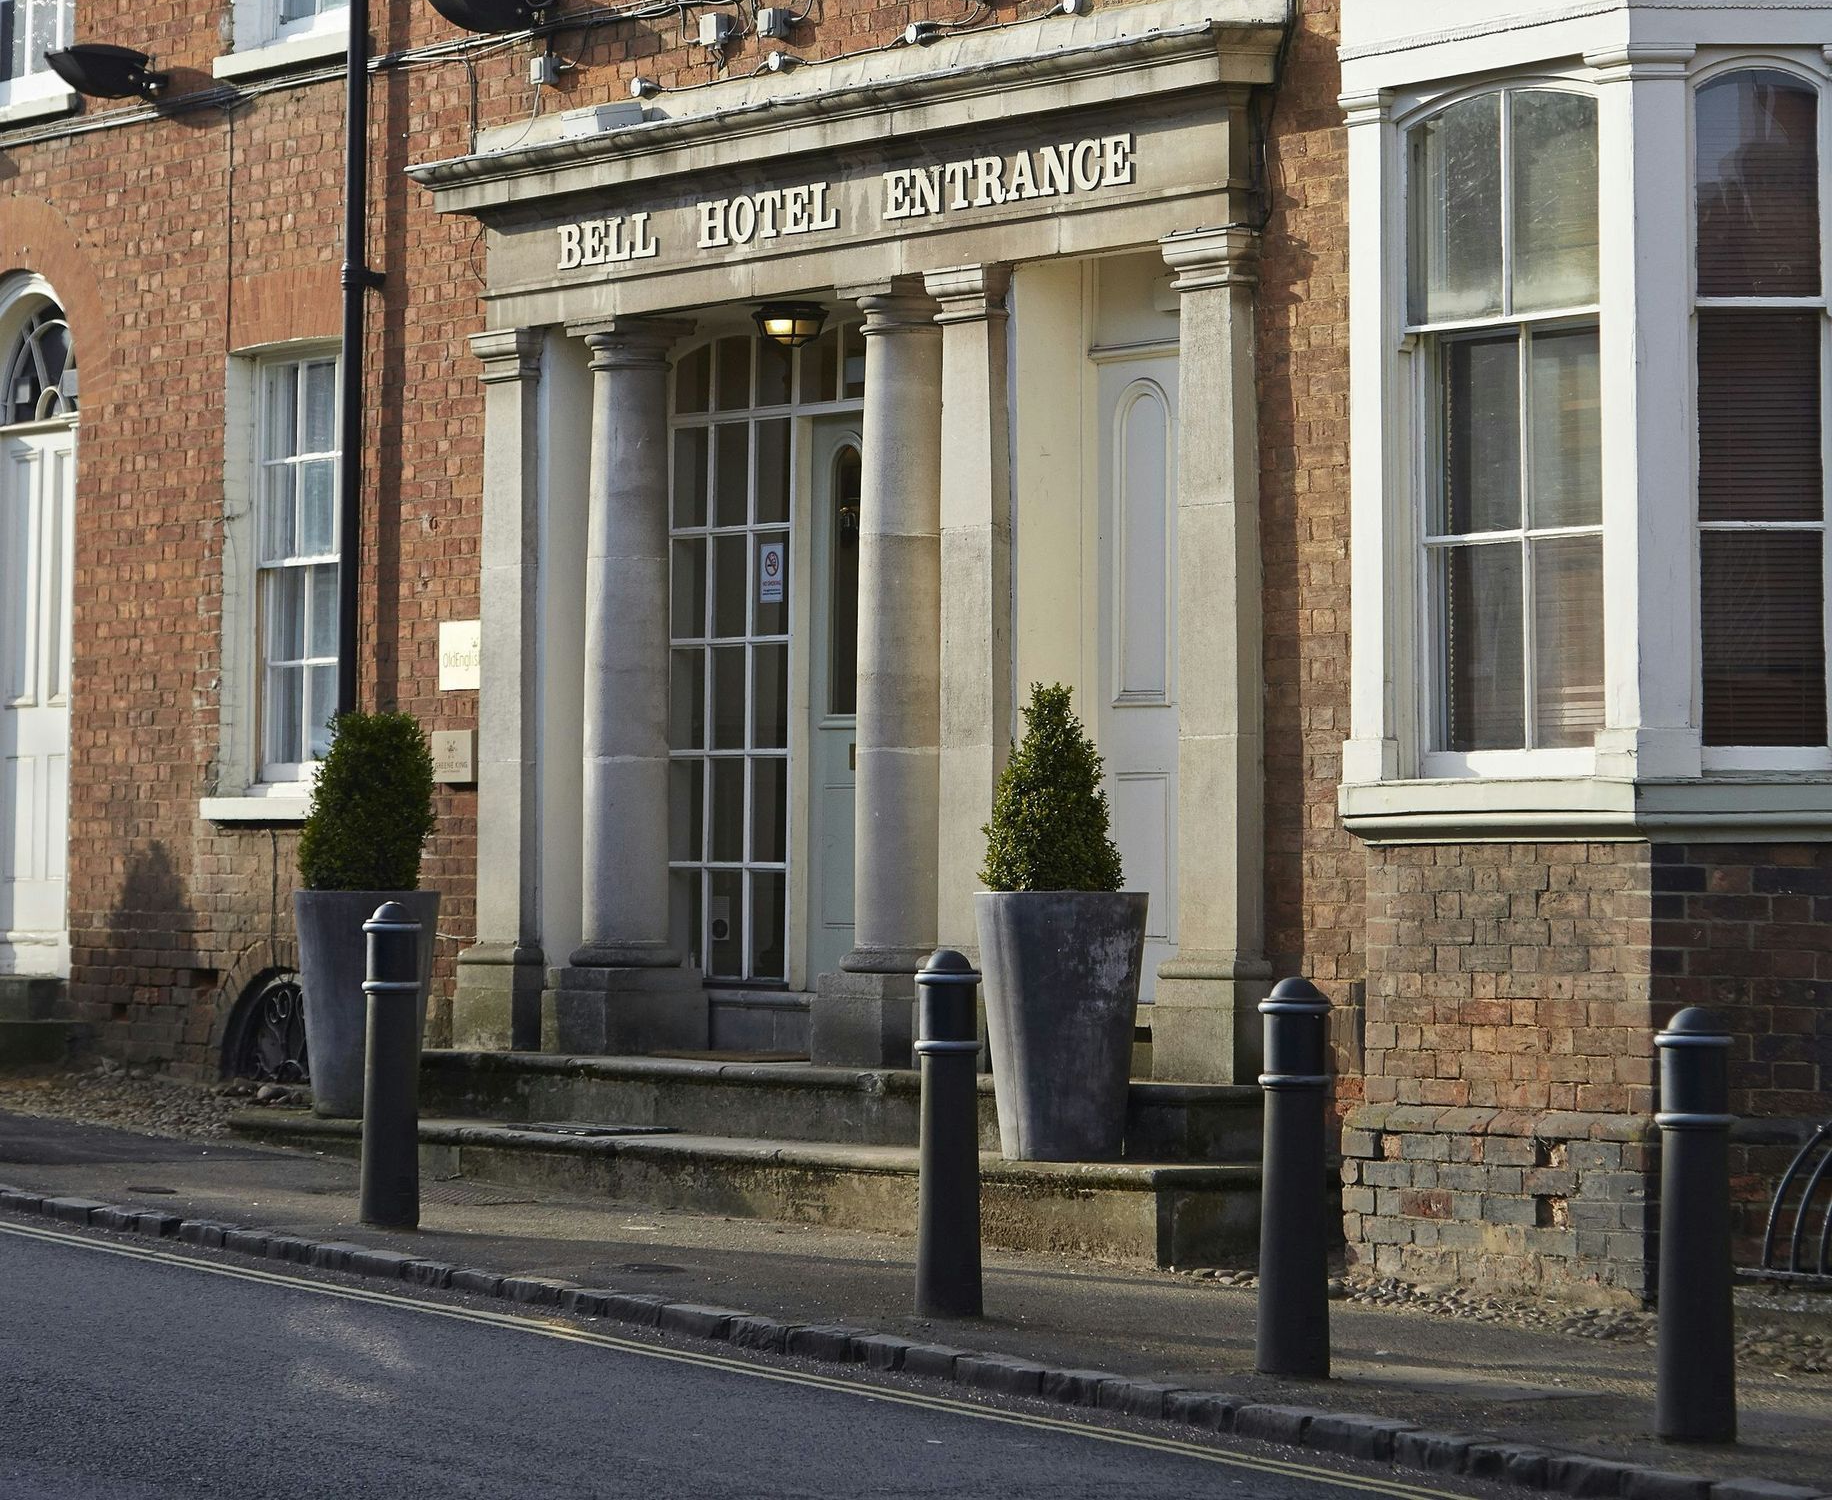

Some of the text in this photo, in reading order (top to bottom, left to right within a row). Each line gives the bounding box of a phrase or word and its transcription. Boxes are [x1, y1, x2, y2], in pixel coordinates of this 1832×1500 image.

[556, 132, 1135, 270] BELL HOTEL ENTRANCE
[442, 650, 480, 672] OldEnglis
[455, 761, 468, 770] KING
